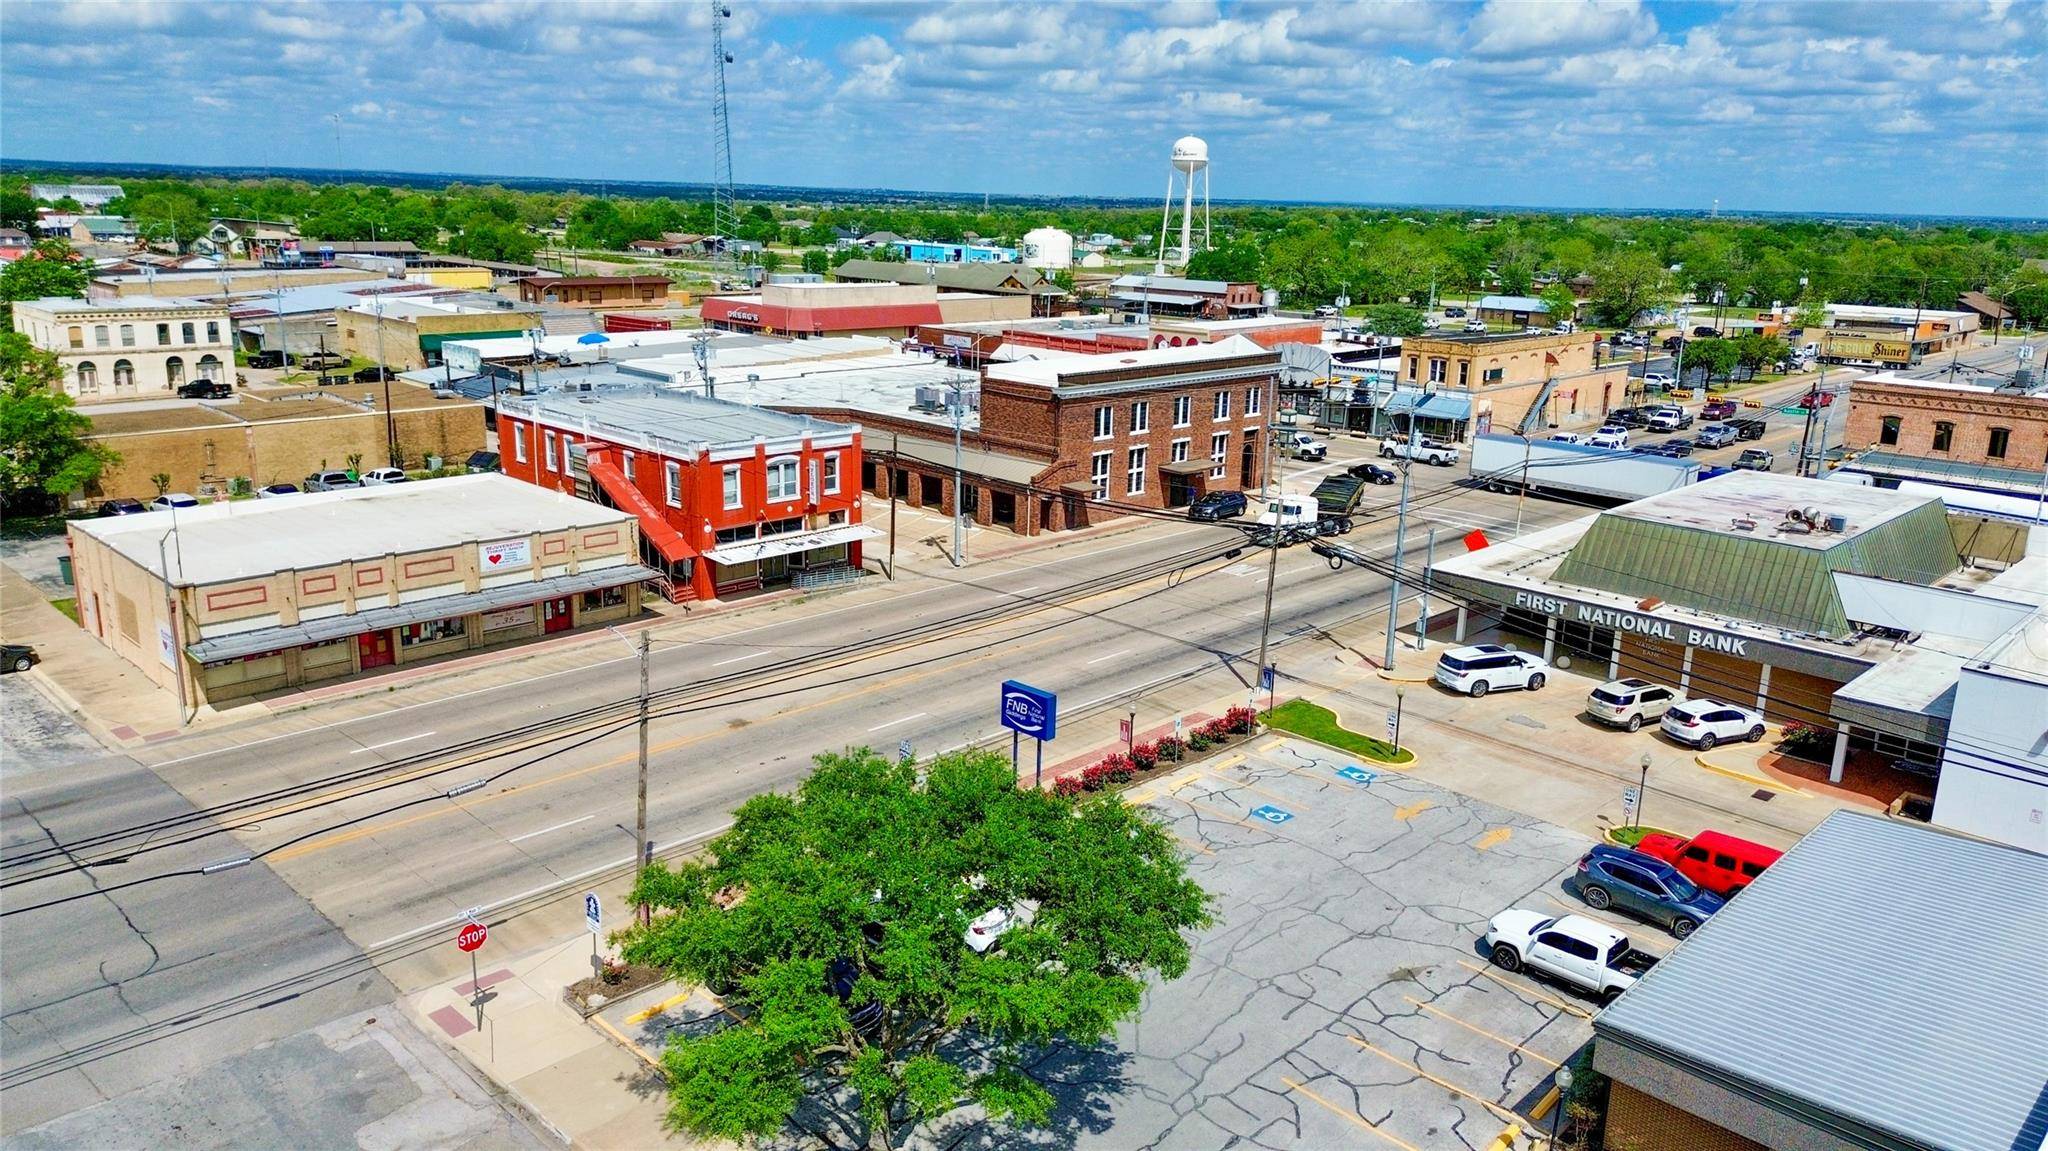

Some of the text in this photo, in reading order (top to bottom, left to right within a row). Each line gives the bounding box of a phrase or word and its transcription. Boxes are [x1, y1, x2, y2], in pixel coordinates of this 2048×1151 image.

[1872, 341, 1907, 358] Shiner
[1515, 591, 1748, 656] FIRST NATIONAL BANK
[1642, 649, 1661, 658] BANK
[1006, 698, 1028, 715] FNB
[459, 928, 486, 947] STOP
